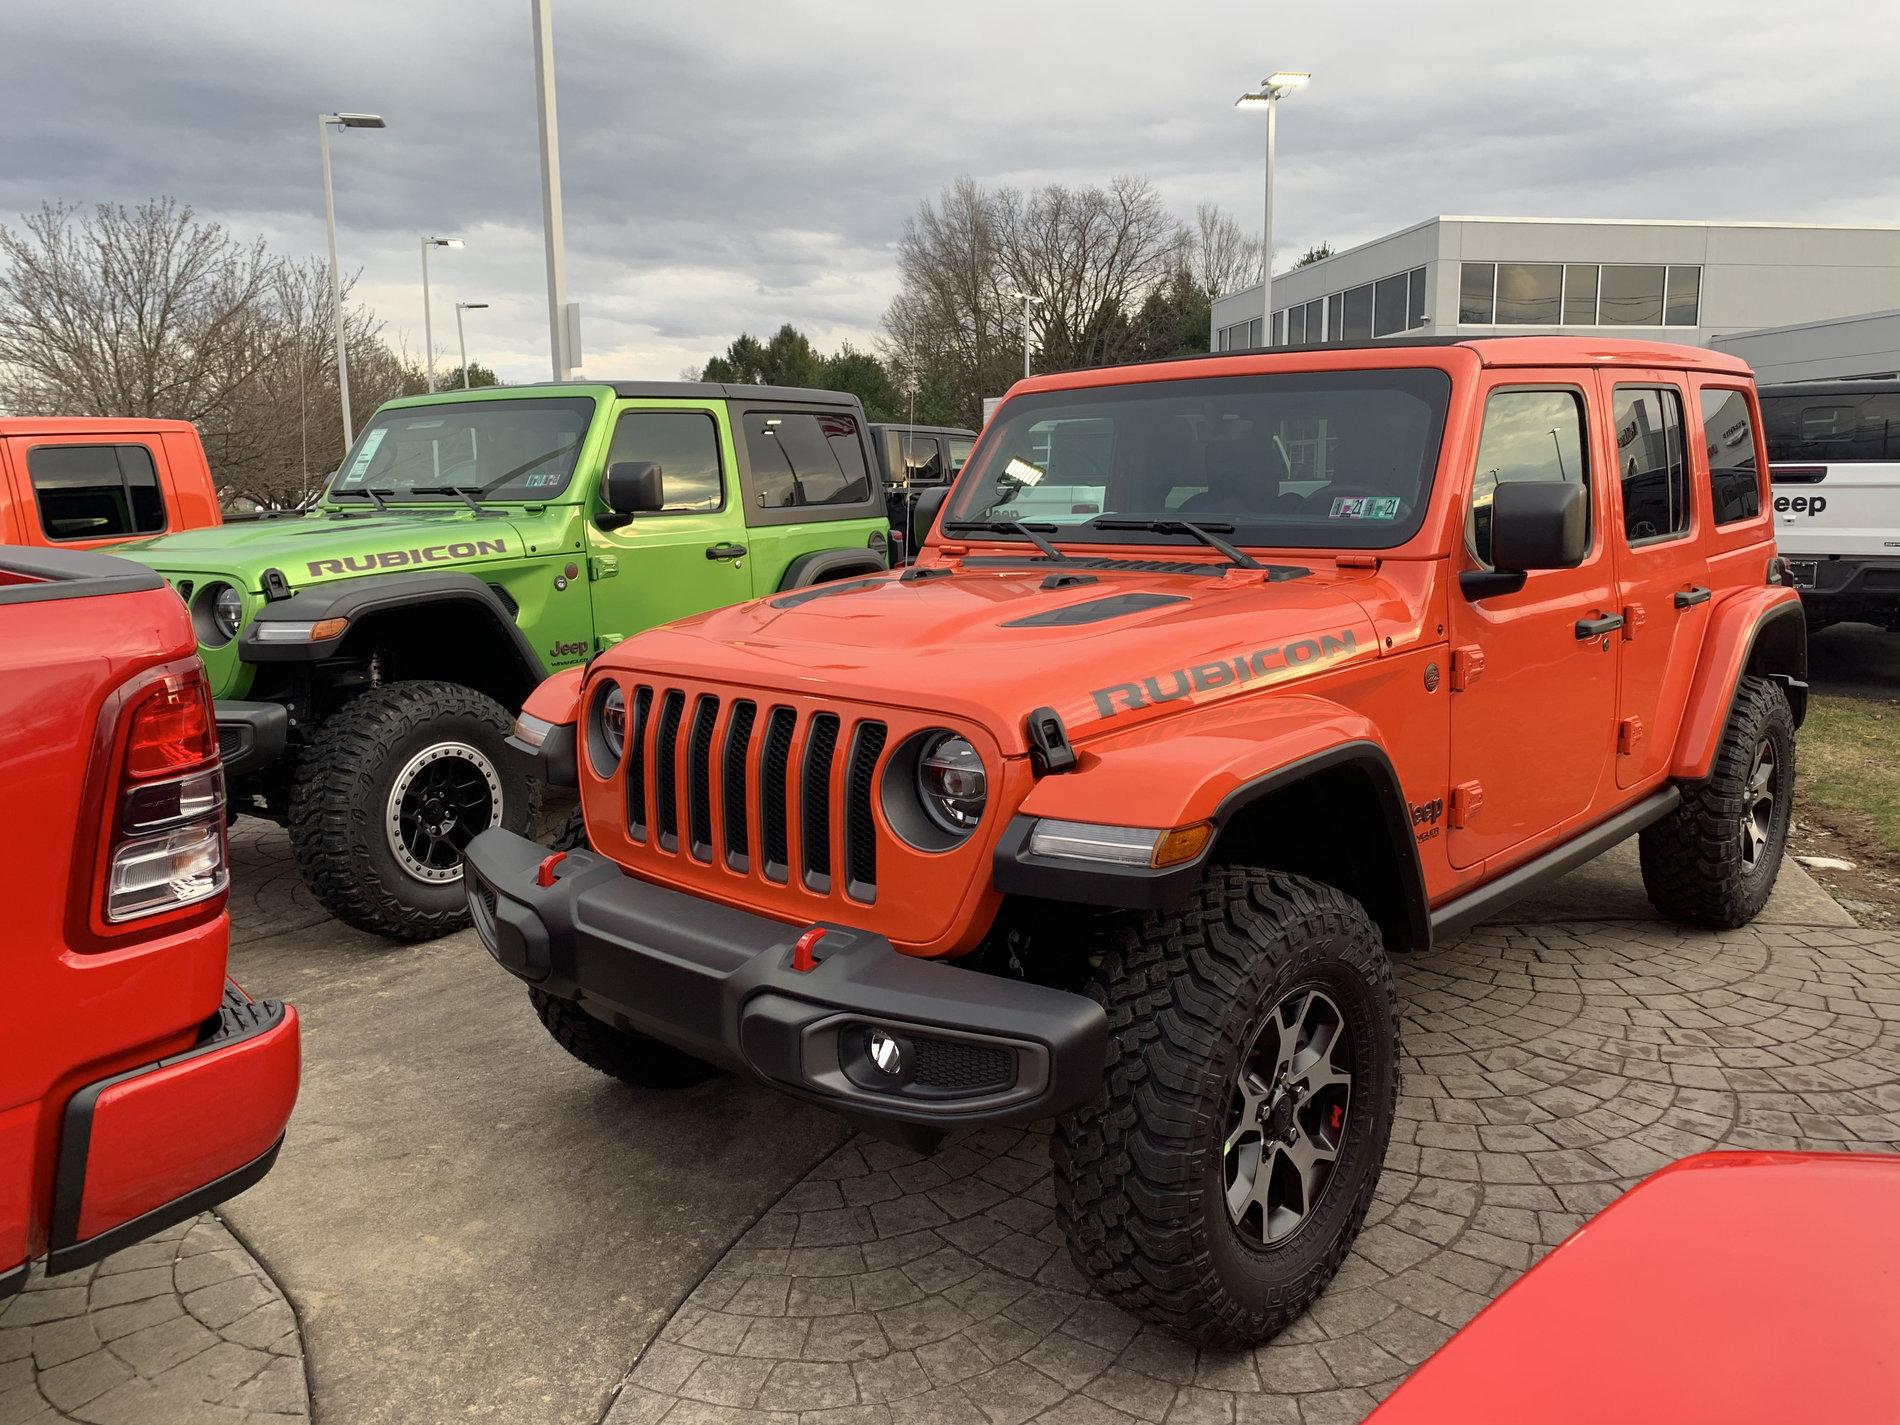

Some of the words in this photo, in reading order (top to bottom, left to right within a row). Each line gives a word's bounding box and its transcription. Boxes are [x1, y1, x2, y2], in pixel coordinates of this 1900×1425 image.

[1773, 496, 1827, 516] eep
[306, 538, 507, 578] RUBICON
[550, 640, 588, 657] Jeep
[1089, 629, 1357, 720] RUBICON
